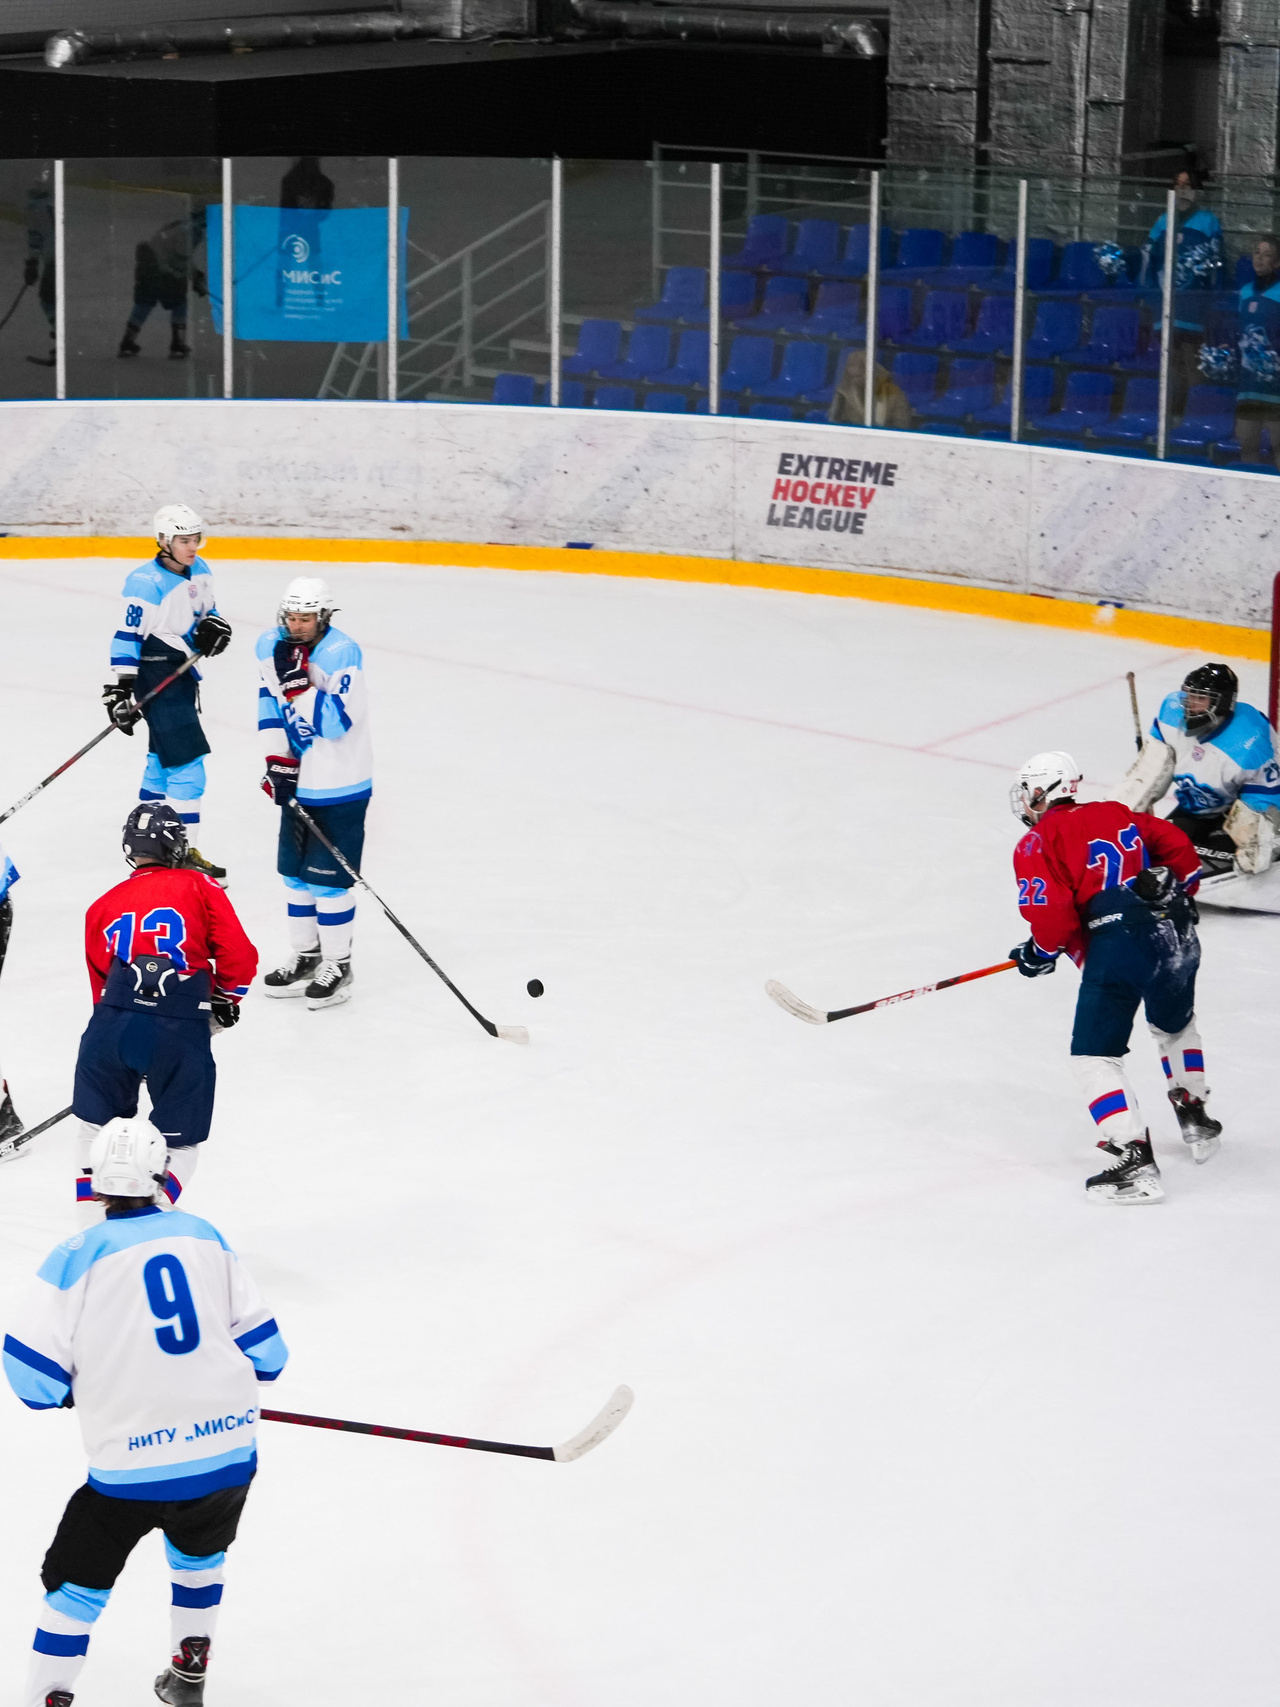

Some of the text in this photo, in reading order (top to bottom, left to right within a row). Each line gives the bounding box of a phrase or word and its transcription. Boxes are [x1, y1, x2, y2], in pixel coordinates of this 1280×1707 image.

[777, 452, 899, 487] EXTREME
[771, 478, 877, 510] HOCKEY
[766, 503, 868, 535] LEAGUE
[1018, 876, 1049, 907] 22
[103, 906, 190, 971] 13
[143, 1253, 201, 1356] 9
[128, 1427, 177, 1451] НИТУ
